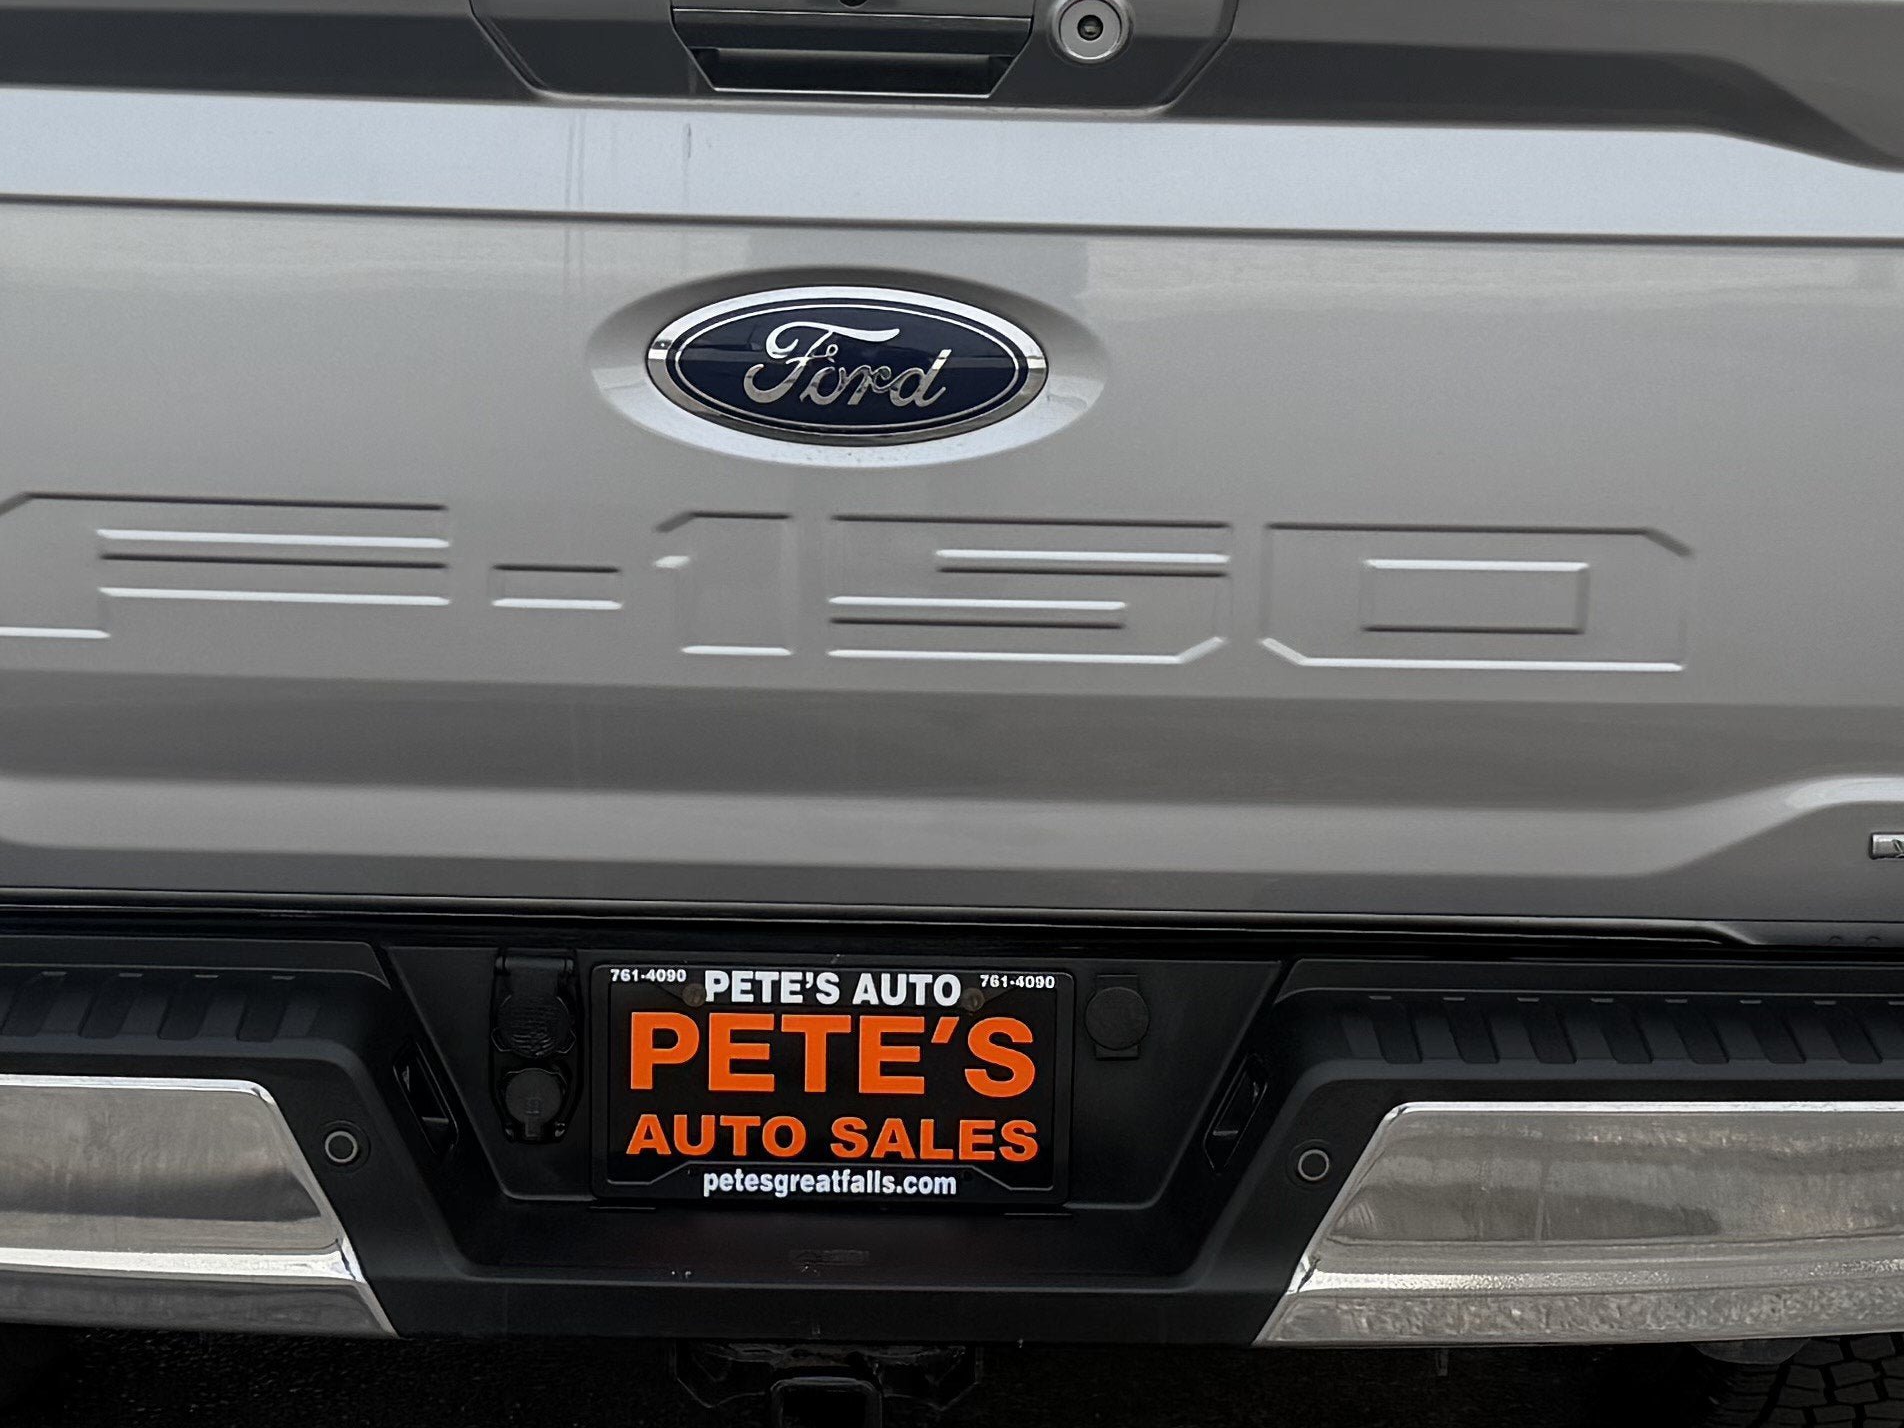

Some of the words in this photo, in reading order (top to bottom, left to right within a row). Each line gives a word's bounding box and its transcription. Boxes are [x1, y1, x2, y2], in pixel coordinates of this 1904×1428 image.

[743, 320, 947, 410] Ford
[610, 968, 687, 983] 761-4090
[705, 970, 841, 1004] PETE'S
[852, 973, 961, 1006] AUTO
[980, 974, 1055, 989] 761-4090
[630, 1012, 1036, 1098] PETE'S
[626, 1113, 807, 1157] AUTO
[830, 1116, 1039, 1162] SALES
[703, 1169, 957, 1197] petesgreatfalls.com
